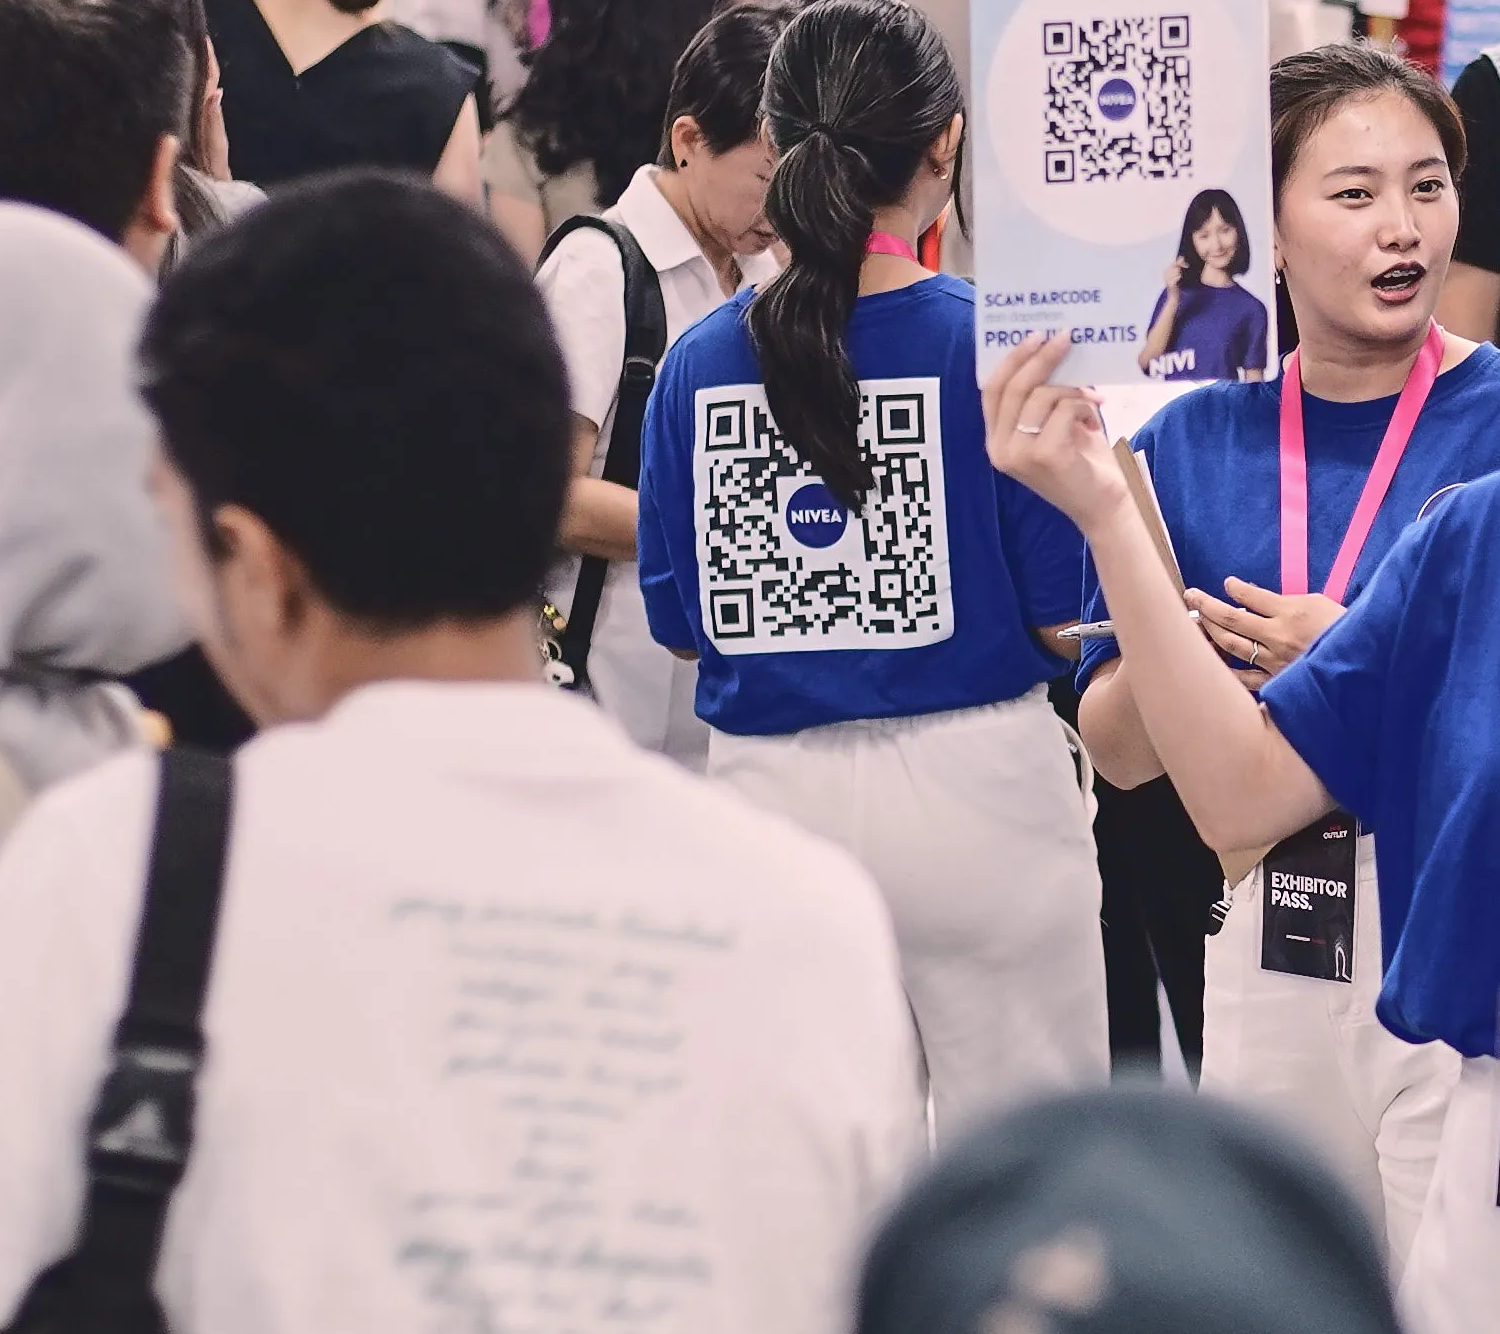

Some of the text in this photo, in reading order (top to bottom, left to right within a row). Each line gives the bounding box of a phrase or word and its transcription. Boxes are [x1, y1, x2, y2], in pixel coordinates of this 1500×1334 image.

[985, 289, 1102, 308] SCAN BARCODE
[985, 325, 1137, 348] PRO GRATIS
[791, 508, 843, 525] NIVEA
[1271, 871, 1348, 899] EXHIBITOR
[1271, 889, 1313, 911] PASS.
